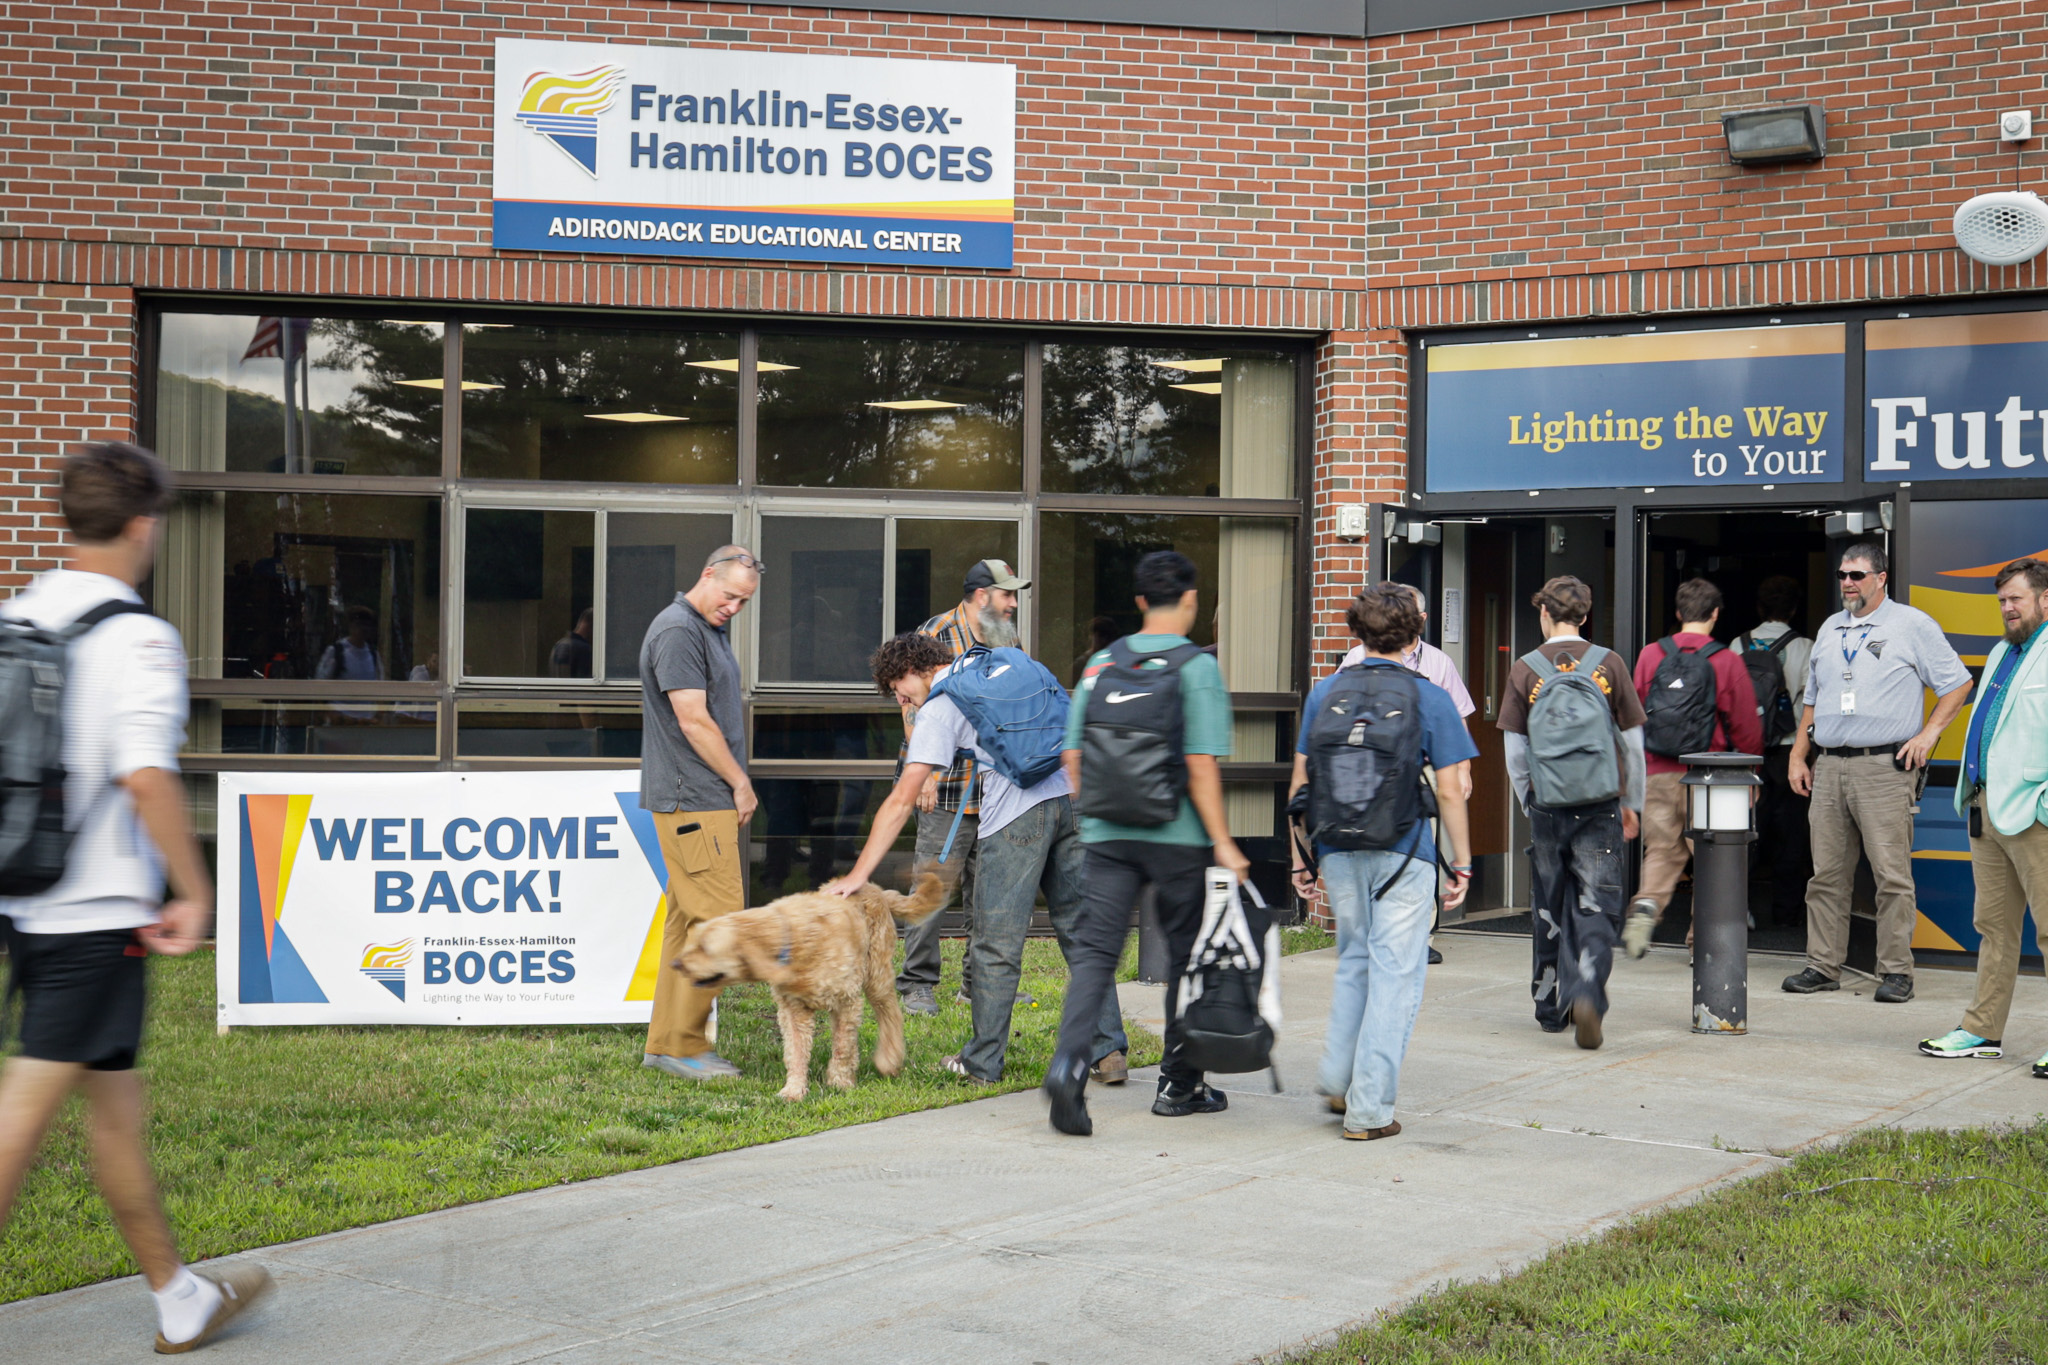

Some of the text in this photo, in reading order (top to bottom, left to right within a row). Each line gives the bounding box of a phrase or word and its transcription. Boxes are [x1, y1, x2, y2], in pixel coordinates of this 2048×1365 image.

[630, 84, 962, 135] Franklin-Essex-
[629, 131, 993, 183] Hamilton BOCES
[548, 216, 962, 253] ADIRONDACK EDUCATIONAL CENTER
[1508, 405, 1829, 453] Lighting the Way
[1870, 395, 2048, 471] Fut
[1692, 444, 1828, 477] to Your
[309, 815, 620, 861] WELCOME
[373, 870, 562, 914] BACK!
[424, 935, 576, 946] Franklin-Essex-Hamilton
[423, 949, 576, 985] BOCES
[423, 992, 575, 1004] Lighting the Way to Your Future
